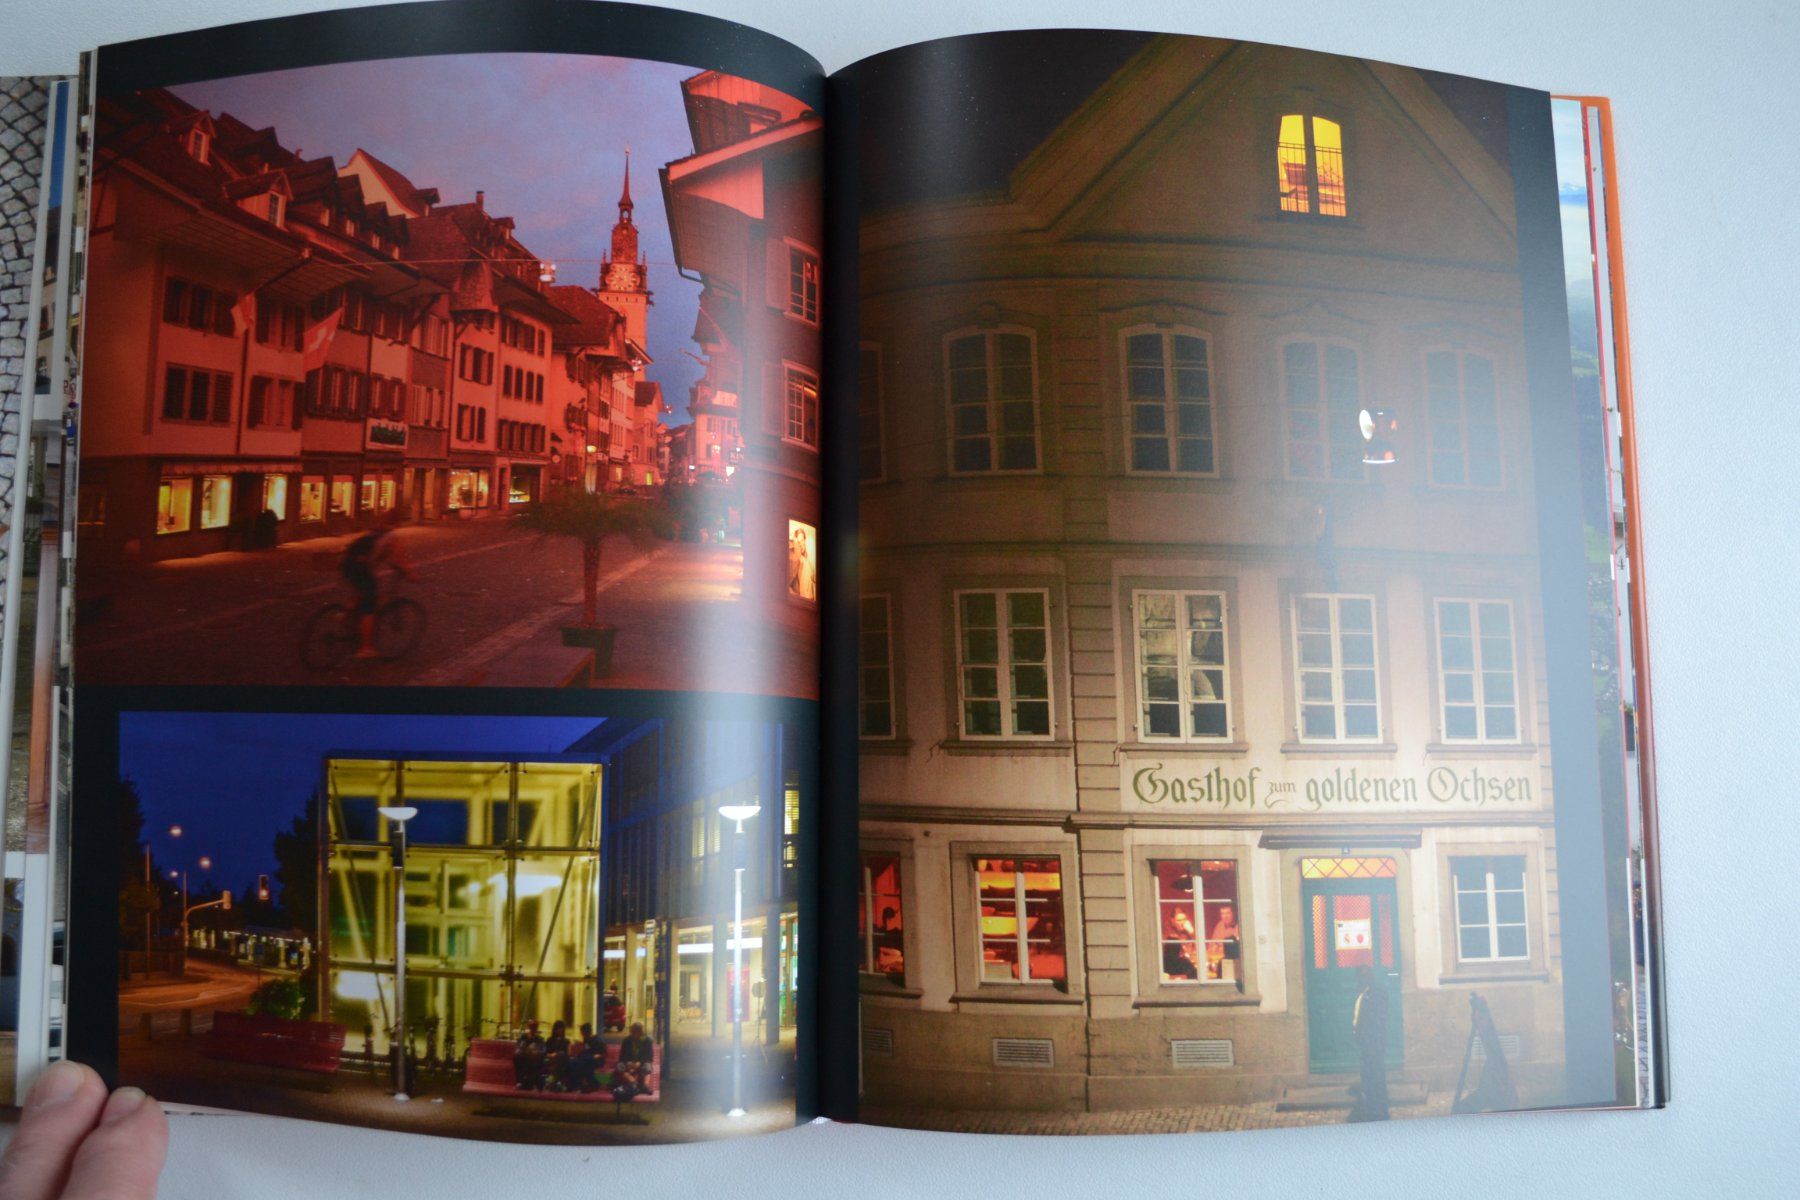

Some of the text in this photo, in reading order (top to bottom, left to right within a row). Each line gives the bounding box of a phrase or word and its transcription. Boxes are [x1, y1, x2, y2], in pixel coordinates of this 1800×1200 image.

[1132, 762, 1532, 812] Gasthof zum goldenen Ochsen
